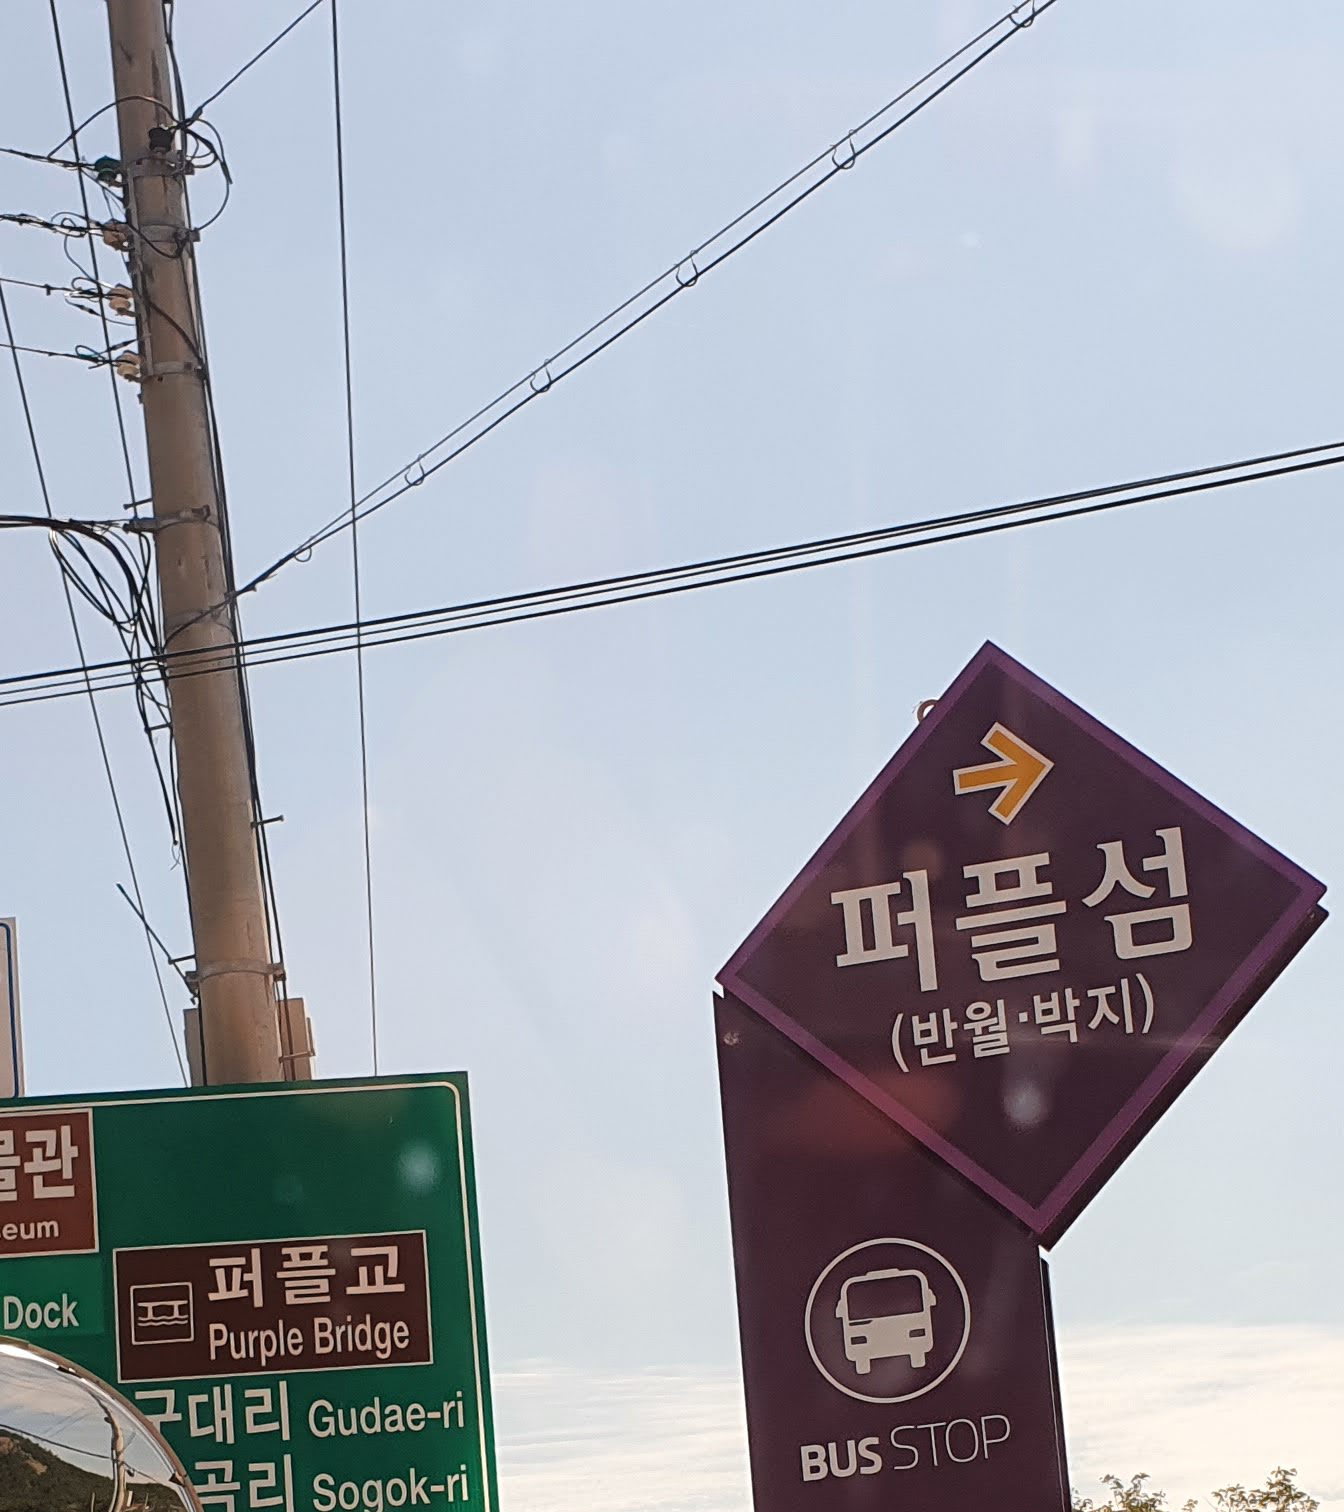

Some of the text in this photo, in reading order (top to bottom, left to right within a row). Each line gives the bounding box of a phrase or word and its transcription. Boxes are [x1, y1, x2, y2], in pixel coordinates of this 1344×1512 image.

[829, 826, 1194, 993] 퍼플섬
[891, 972, 1155, 1073] (반월·박지)
[206, 1244, 406, 1308] 퍼플교
[3, 1293, 79, 1330] Dock
[208, 1314, 411, 1367] Purple Bridge
[134, 1380, 466, 1444] 구대리 Gudae-ri
[800, 1414, 1011, 1482] BUS STOP
